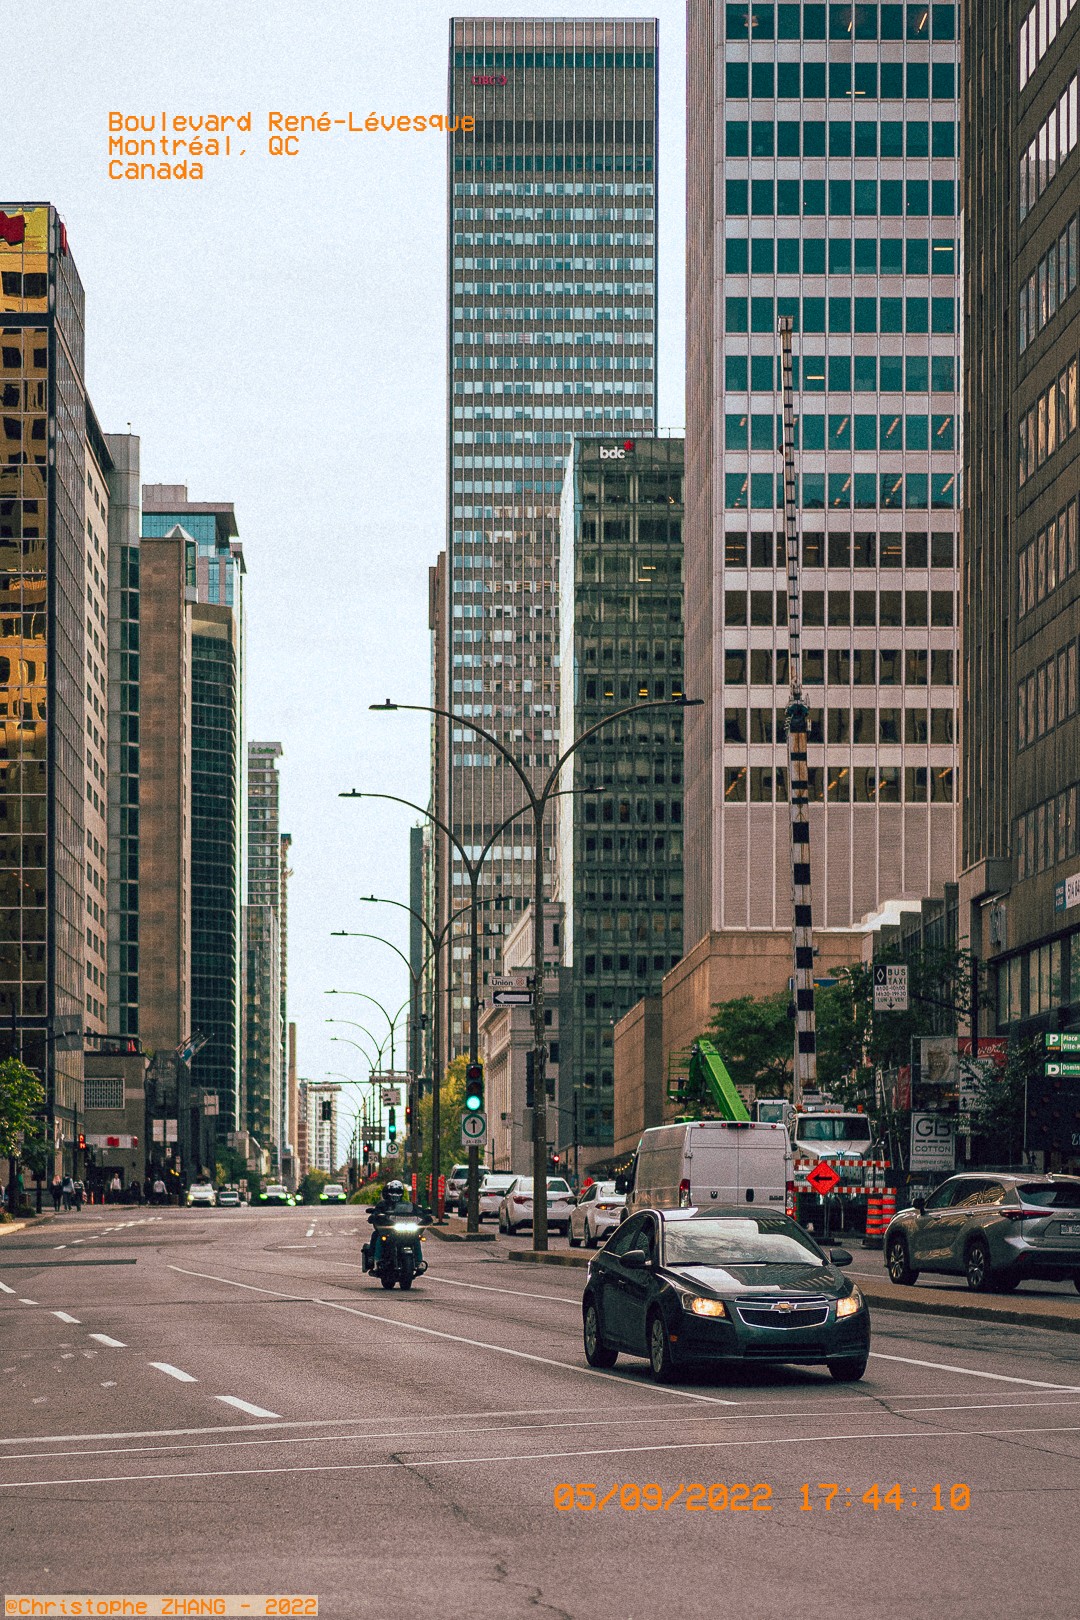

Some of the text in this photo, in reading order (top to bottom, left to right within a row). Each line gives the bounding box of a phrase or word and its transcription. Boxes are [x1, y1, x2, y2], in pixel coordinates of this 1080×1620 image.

[471, 75, 496, 85] CIBC
[600, 446, 626, 459] bdc
[888, 977, 906, 985] TAXI
[1050, 1034, 1059, 1045] P
[916, 1118, 951, 1136] GB
